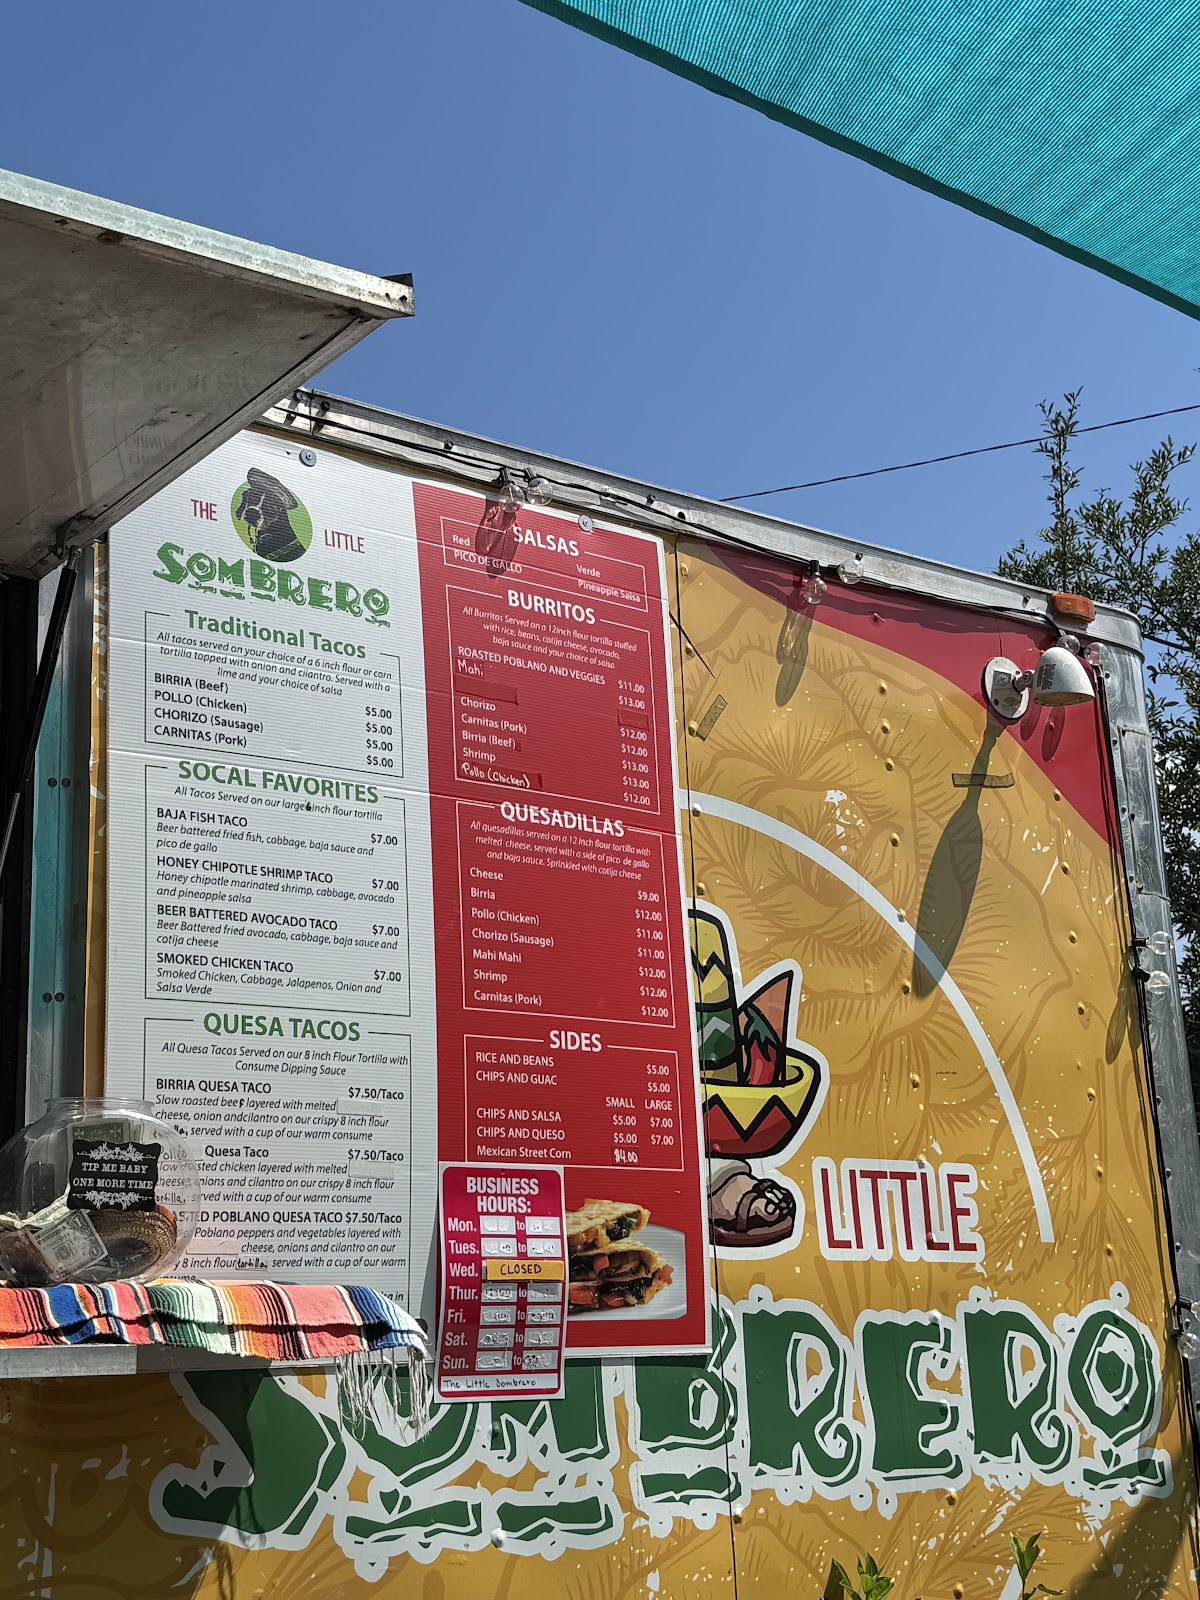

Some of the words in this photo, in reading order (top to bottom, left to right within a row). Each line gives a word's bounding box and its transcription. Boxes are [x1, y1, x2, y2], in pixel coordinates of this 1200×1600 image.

[190, 498, 217, 522] THE
[324, 529, 365, 554] LITTLE
[453, 534, 470, 546] Red
[512, 524, 579, 556] SALSAS
[454, 550, 476, 563] PICO
[493, 559, 522, 573] GALLO
[576, 564, 600, 578] Verde
[153, 542, 390, 627] SOMBRERO
[578, 580, 619, 597] Pineapple
[620, 590, 640, 602] Salsa
[508, 590, 595, 624] BURRITOS
[184, 610, 304, 648] Traditional
[309, 632, 366, 659] Tacos
[458, 646, 501, 662] ROASTED
[504, 655, 547, 672] POBLANO
[549, 665, 568, 676] AND
[569, 669, 605, 685] VEGGIES
[155, 673, 192, 687] BIRRIA
[196, 679, 228, 694] (Beef)
[618, 680, 645, 693] $11.00
[155, 690, 193, 704] POLLO
[196, 696, 247, 714] (Chicken)
[461, 696, 496, 711] Chorizo
[619, 696, 645, 709] $13.00
[366, 706, 392, 719] $5.00
[155, 708, 207, 724] CHORIZO
[211, 715, 263, 733] (Sausage)
[366, 722, 392, 735] $5.00
[621, 727, 647, 741] $12.00
[154, 725, 211, 741] CARNITAS
[215, 733, 246, 748] (Pork)
[462, 730, 486, 743] Birria
[489, 735, 515, 749] (Beef)
[366, 738, 393, 752] $5.00
[367, 755, 393, 768] $5.00
[463, 747, 496, 763] Shrimp
[622, 760, 648, 773] $13.00
[179, 761, 256, 787] SOCAL
[263, 771, 378, 803] FAVORITES
[623, 776, 649, 789] $13.00
[624, 792, 650, 805] $12.00
[157, 807, 187, 820] BAJA
[190, 811, 215, 823] FISH
[218, 814, 247, 827] TACO
[499, 801, 624, 837] QUESADILLAS
[157, 822, 178, 833] Beer
[180, 824, 221, 838] battered
[223, 829, 244, 840] fried
[246, 832, 264, 843] fish,
[266, 836, 307, 849] cabbage,
[309, 840, 329, 852] baja
[331, 844, 356, 853] sauce
[371, 833, 398, 845] $7.00
[156, 838, 177, 848] pico
[179, 840, 192, 850] de
[193, 842, 217, 853] gallo
[158, 856, 199, 869] HONEY
[202, 860, 257, 875] CHIPOTLE
[260, 866, 302, 879] SHRIMP
[305, 871, 333, 883] TACO
[470, 867, 503, 880] Cheese
[372, 878, 399, 891] $7.00
[471, 887, 495, 899] Birria
[638, 890, 659, 902] $9.00
[158, 904, 186, 916] BEER
[190, 907, 248, 922] BATTERED
[251, 913, 307, 927] AVOCADO
[309, 918, 337, 930] TACO
[635, 909, 662, 921] $12.00
[373, 924, 399, 936] $7.00
[472, 928, 508, 941] Chorizo
[510, 932, 554, 947] (Sausage)
[638, 947, 664, 959] $11.00
[157, 952, 208, 966] SMOKED
[212, 956, 261, 970] CHICKEN
[264, 961, 293, 973] TACO
[157, 968, 196, 979] Smoked
[198, 971, 237, 983] Chicken,
[241, 974, 284, 988] Cabbage,
[286, 978, 333, 991] Jalapenos,
[336, 981, 363, 992] Onion
[365, 985, 382, 993] and
[374, 970, 401, 982] $7.00
[157, 982, 182, 993] Salsa
[186, 984, 212, 995] Verde
[474, 990, 513, 1003] Carnitas
[515, 994, 542, 1006] (Pork)
[642, 1005, 668, 1017] $12.00
[204, 1013, 284, 1037] QUESA
[289, 1018, 360, 1041] TACOS
[550, 1030, 602, 1052] SIDES
[476, 1052, 497, 1063] RICE
[500, 1054, 521, 1064] AND
[523, 1055, 554, 1067] BEANS
[647, 1064, 669, 1075] $5.00
[157, 1078, 195, 1090] BIRRIA
[199, 1080, 239, 1092] QUESA
[241, 1082, 271, 1094] TACO
[349, 1087, 404, 1100] $7.50/Taco
[606, 1097, 635, 1108] SMALL
[645, 1099, 672, 1110] LARGE
[477, 1108, 505, 1119] CHIPS
[508, 1109, 529, 1120] AND
[532, 1110, 561, 1122] SALSA
[613, 1115, 636, 1126] $5.00
[650, 1117, 673, 1128] $7.00
[205, 1145, 240, 1157] Quesa
[243, 1146, 269, 1158] Taco
[348, 1149, 404, 1161] $7.50/Taco
[477, 1145, 517, 1156] Mexican
[519, 1147, 547, 1158] Street
[549, 1148, 571, 1158] Corn
[82, 1163, 99, 1171] TIP
[100, 1164, 117, 1172] ME
[119, 1164, 148, 1174] BABY
[73, 1178, 94, 1186] ONE
[96, 1179, 126, 1188] MORE
[128, 1180, 153, 1189] TIME
[466, 1177, 539, 1195] BUSINESS
[477, 1196, 531, 1213] HOURS:
[819, 1166, 979, 1253] LITTLE
[213, 1211, 270, 1222] POBLANO
[273, 1212, 311, 1223] QUESA
[314, 1212, 343, 1223] TACO
[346, 1212, 402, 1223] $7.50/Taco
[448, 1218, 477, 1232] Mon.
[516, 1220, 525, 1231] to
[449, 1240, 479, 1254] Tues.
[518, 1243, 526, 1253] to
[449, 1263, 478, 1277] Wed.
[500, 1264, 542, 1275] CLOSED
[449, 1286, 478, 1300] Thur.
[519, 1287, 527, 1298] to
[447, 1309, 466, 1323] Fri.
[517, 1310, 525, 1320] to
[445, 1332, 468, 1346] Sat.
[515, 1333, 524, 1343] to
[442, 1355, 469, 1369] Sun.
[513, 1356, 522, 1366] to
[443, 1380, 460, 1388] The
